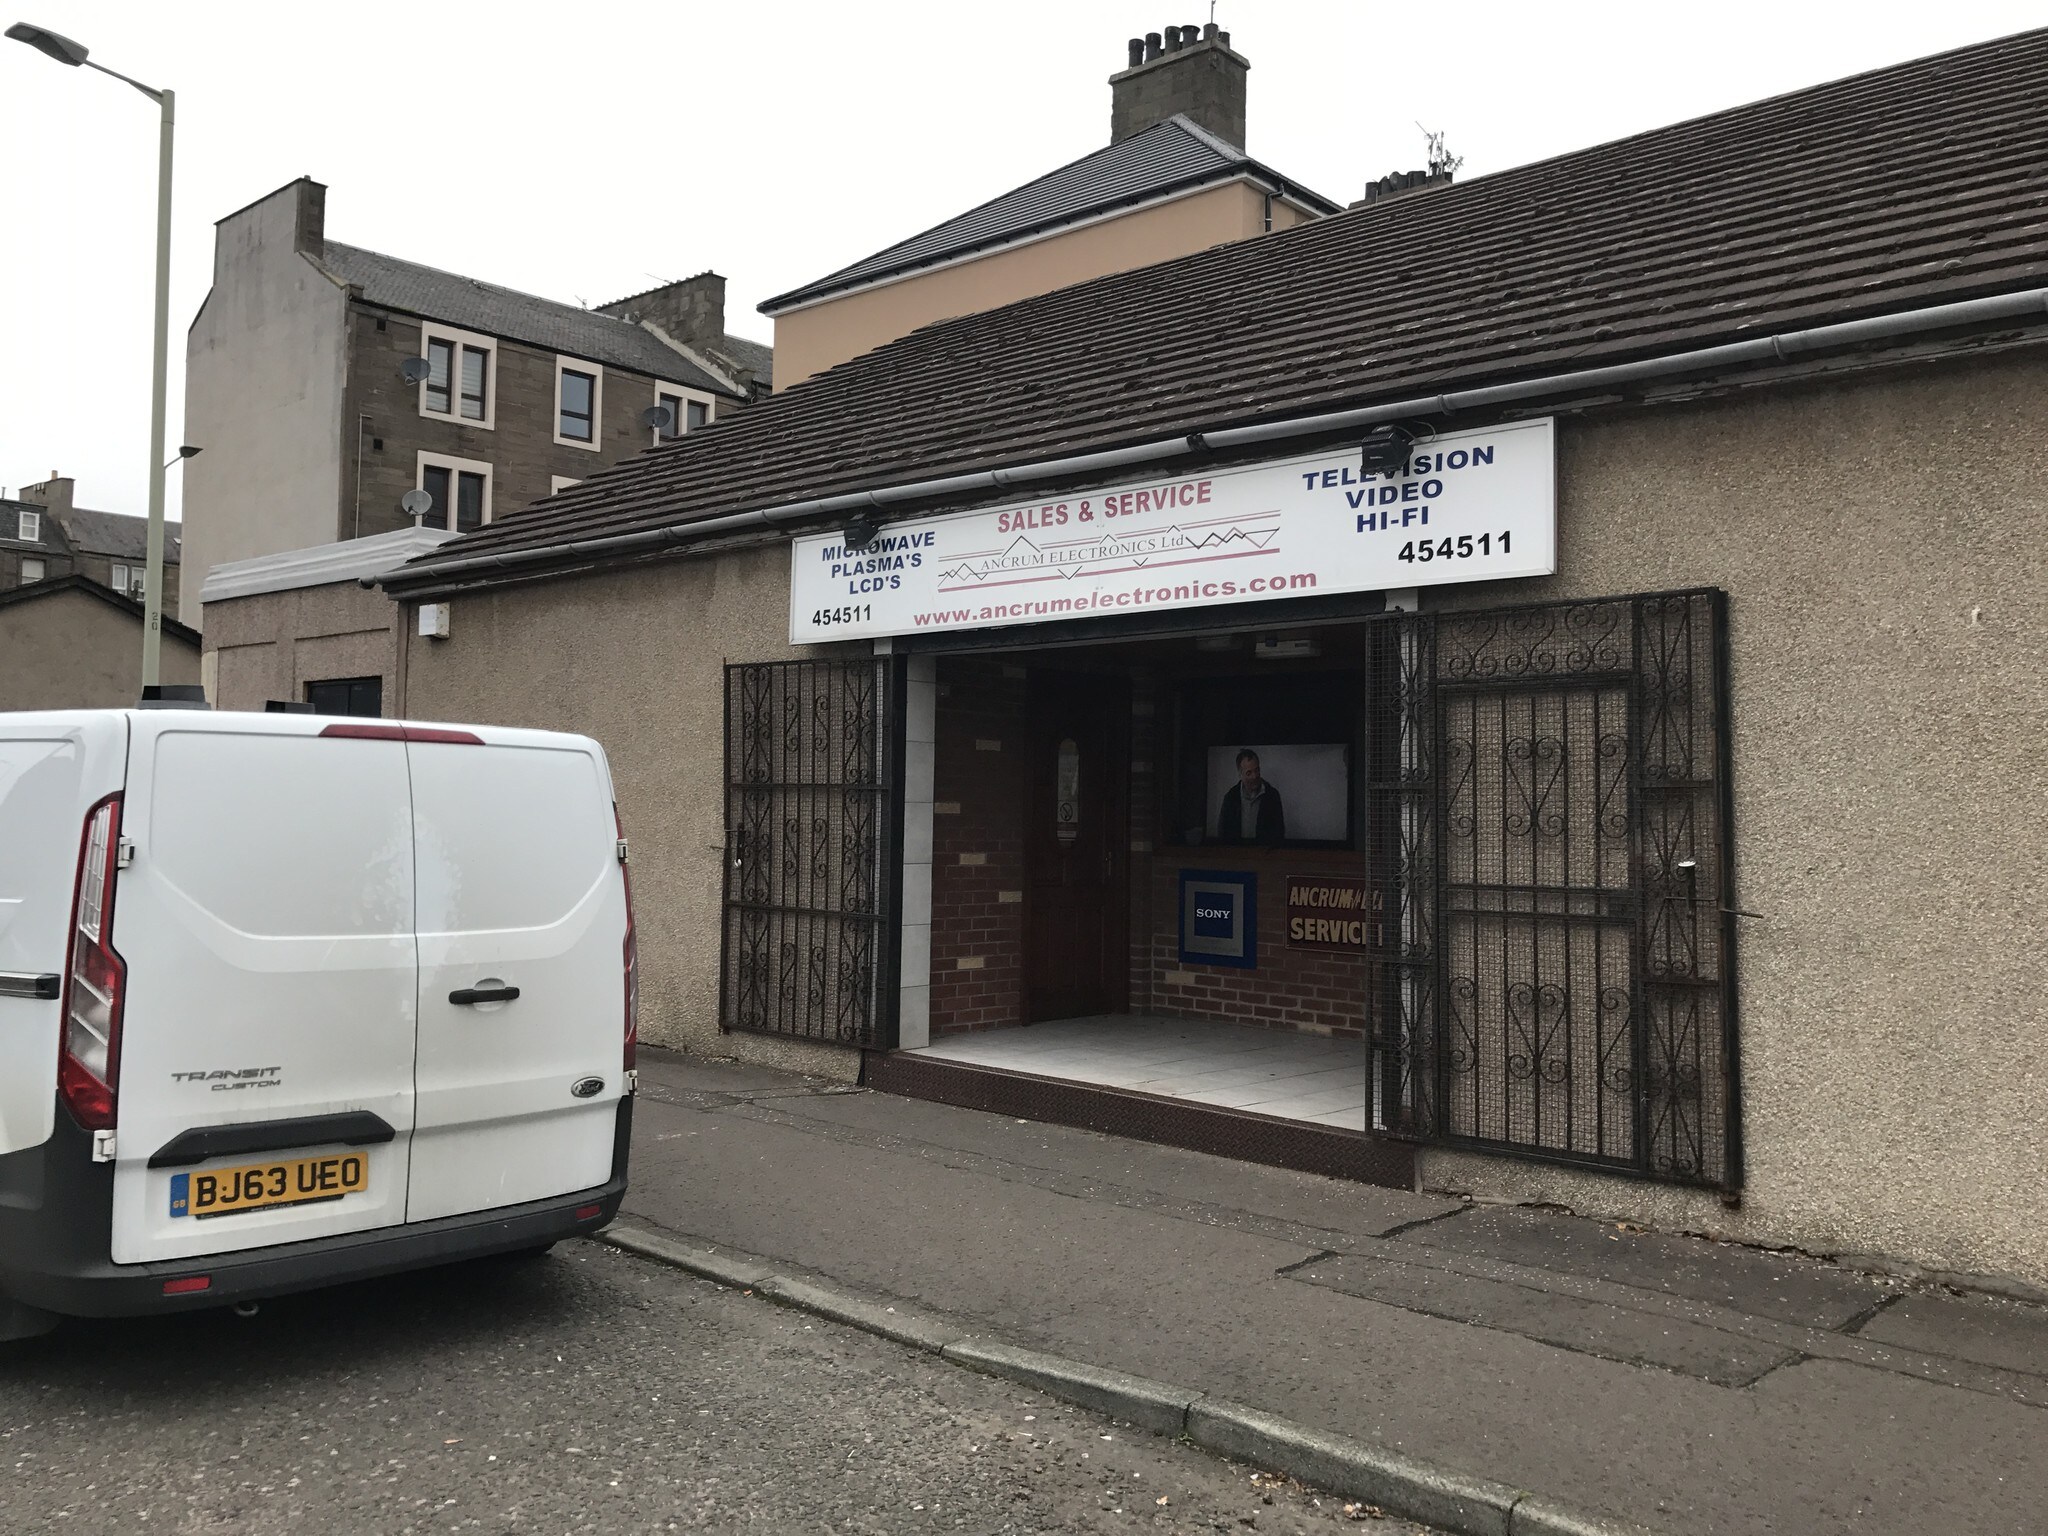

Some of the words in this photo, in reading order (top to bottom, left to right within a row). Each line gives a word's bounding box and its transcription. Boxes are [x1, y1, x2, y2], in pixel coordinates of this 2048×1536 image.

[997, 504, 1069, 534] SALES
[1078, 500, 1094, 523] &
[1104, 481, 1212, 518] SERVICE
[1345, 479, 1443, 509] VIDEO
[1356, 506, 1429, 533] HI-FI
[980, 553, 1044, 571] ANCRUM
[1049, 538, 1156, 563] ELECTRONICS
[1161, 533, 1184, 549] Ltd
[1398, 530, 1511, 564] 454511
[831, 553, 922, 578] PLASMA'S
[849, 575, 901, 595] LCD'S
[913, 571, 1317, 626] www.ancrumelectronics.com
[812, 604, 872, 627] 454511
[1196, 908, 1231, 919] SONY
[171, 1066, 281, 1082] TRANSIT
[211, 1080, 281, 1091] CUSTOM
[195, 1166, 287, 1207] BJ63
[297, 1157, 361, 1193] UEO
